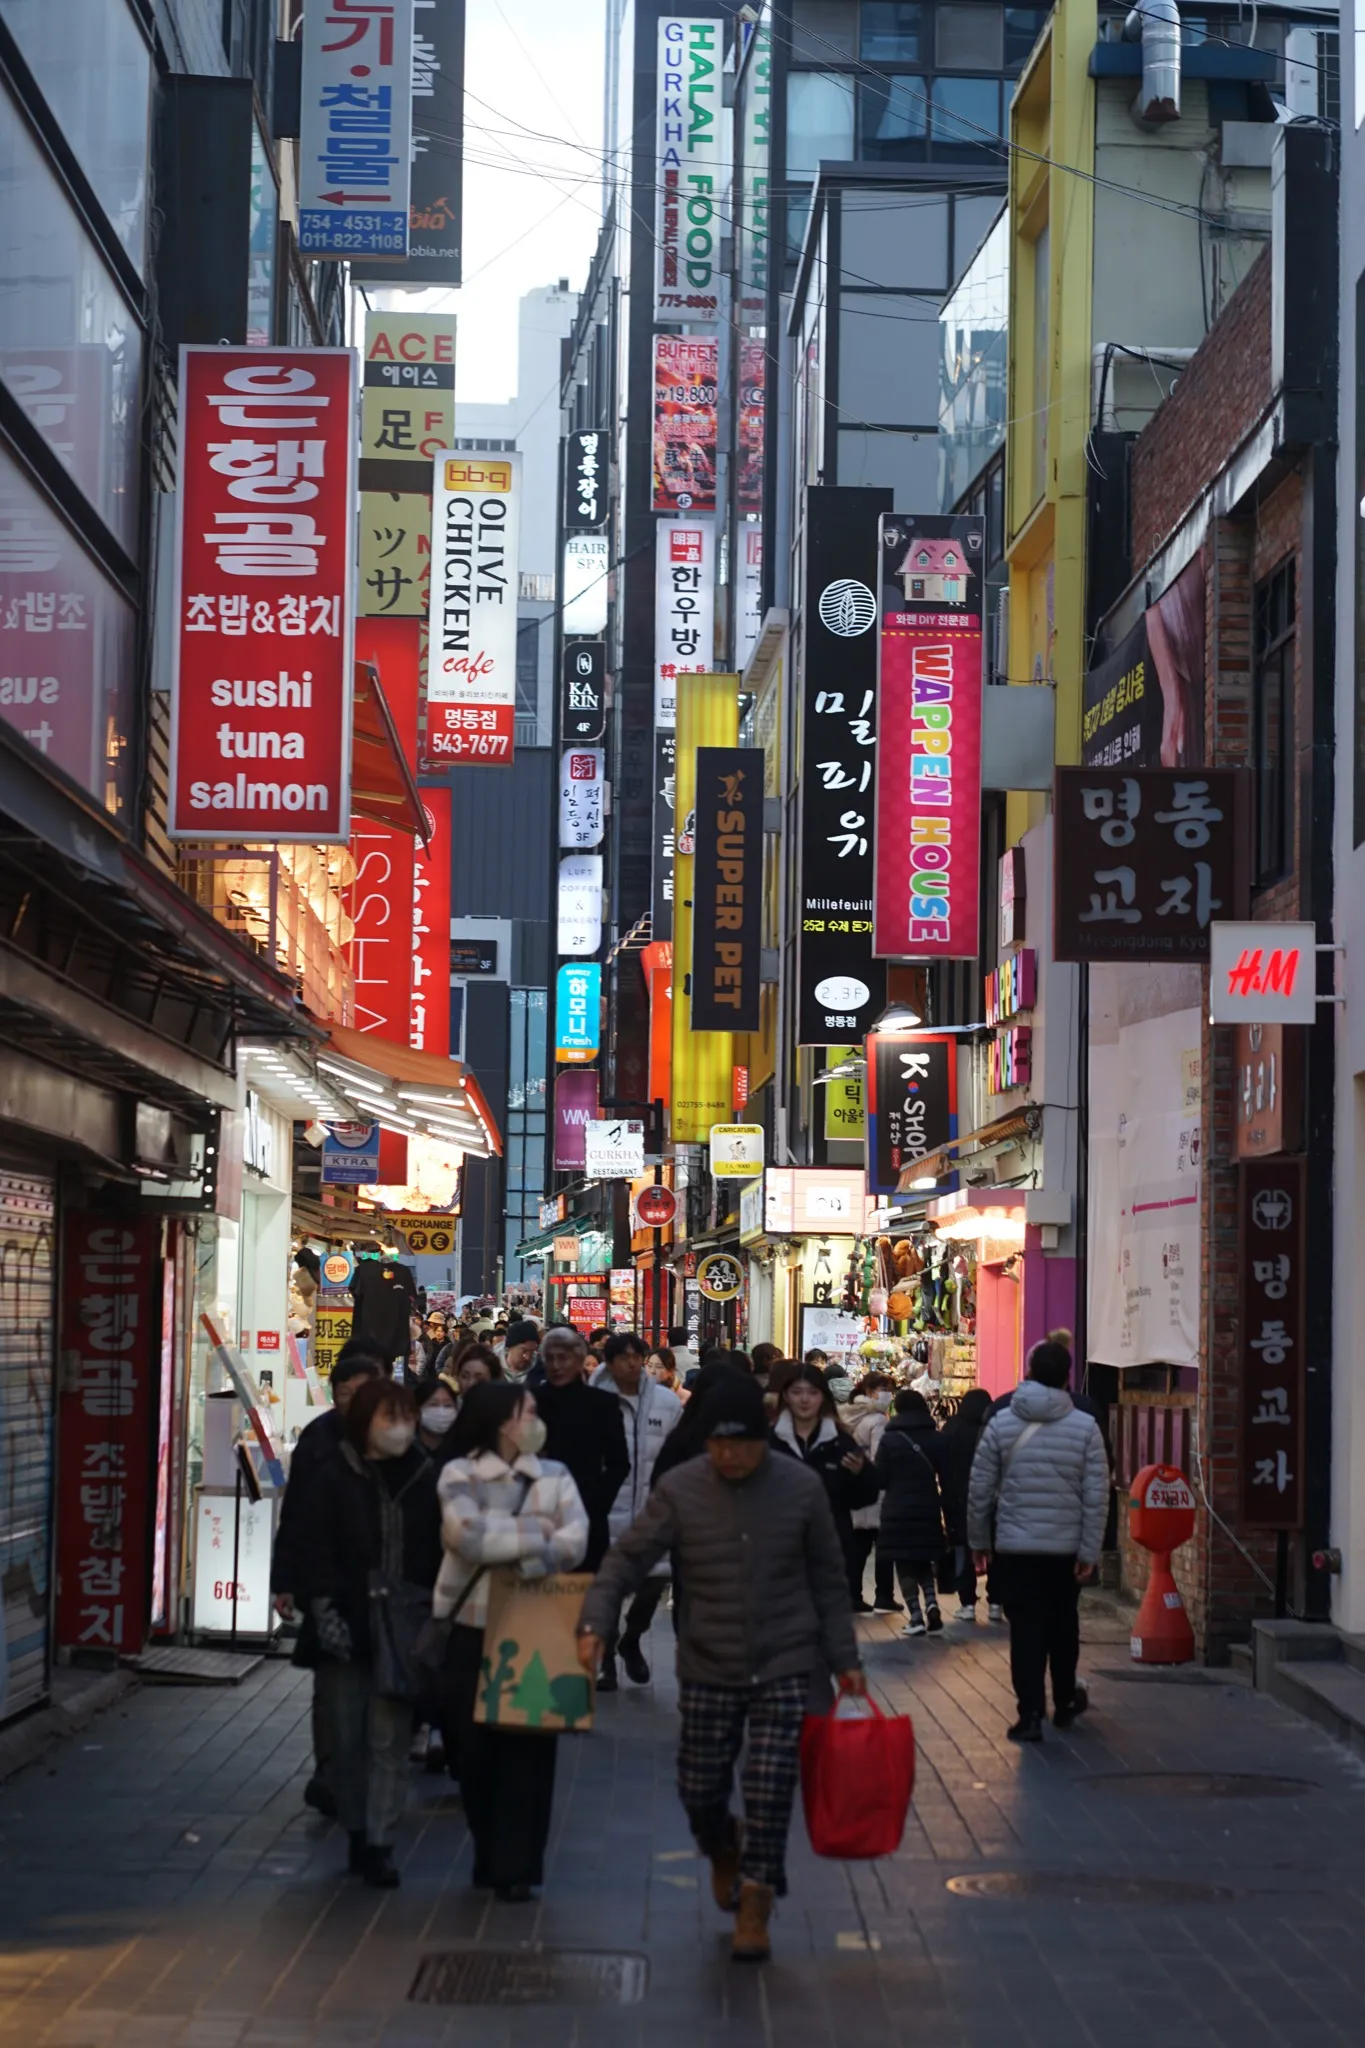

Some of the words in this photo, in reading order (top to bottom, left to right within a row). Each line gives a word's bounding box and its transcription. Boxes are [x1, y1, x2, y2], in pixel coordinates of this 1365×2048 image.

[317, 0, 400, 186] 기·철물
[662, 22, 684, 167] GURKHA
[687, 24, 715, 153] HALAL
[302, 232, 404, 249] 011-822-1108
[686, 174, 713, 289] FOOD
[408, 246, 460, 257] obia.net
[369, 333, 453, 363] ACE
[657, 343, 716, 359] BUFFET
[382, 365, 439, 386] 에이스
[375, 409, 418, 452] 足
[204, 364, 330, 577] 은행골
[576, 433, 600, 521] 명동장어
[476, 498, 508, 605] OLIVE
[567, 542, 606, 555] HAIR
[576, 557, 606, 570] SPA
[443, 497, 474, 652] CHICKEN
[184, 593, 341, 638] 초밥&참치
[670, 565, 703, 656] 한우방
[918, 614, 935, 625] DIY
[938, 614, 969, 627] 전문점
[443, 650, 495, 684] cafe
[211, 671, 312, 708] sushi
[444, 708, 497, 730] 명동점
[576, 722, 590, 732] 4F
[910, 644, 953, 806] WAPPEN
[217, 723, 304, 760] tuna
[432, 733, 509, 756] 543-7677
[190, 774, 328, 812] salmon
[1079, 777, 1224, 849] 명동
[575, 832, 590, 841] 3F
[715, 810, 746, 930] SUPER
[908, 815, 952, 944] HOUSE
[1078, 860, 1223, 929] 교자
[572, 937, 586, 945] 2F
[714, 942, 743, 1009] PET
[1227, 948, 1300, 997] H&M
[568, 977, 589, 1036] 하모니
[825, 1015, 857, 1028] 명동점
[562, 1035, 592, 1046] Fresh
[899, 1053, 930, 1079] K
[563, 1109, 590, 1125] WM
[628, 1123, 641, 1133] 5F
[332, 1157, 369, 1166] KTRA
[590, 1150, 640, 1160] GURKHA
[593, 1168, 638, 1176] RESTAURANT
[401, 1219, 453, 1230] EXCHANGE
[326, 1263, 348, 1275] 담배
[571, 1299, 604, 1310] BUFFET
[76, 1227, 142, 1417] 은행골
[314, 1349, 338, 1369] 現
[1249, 1254, 1294, 1495] 명동교자
